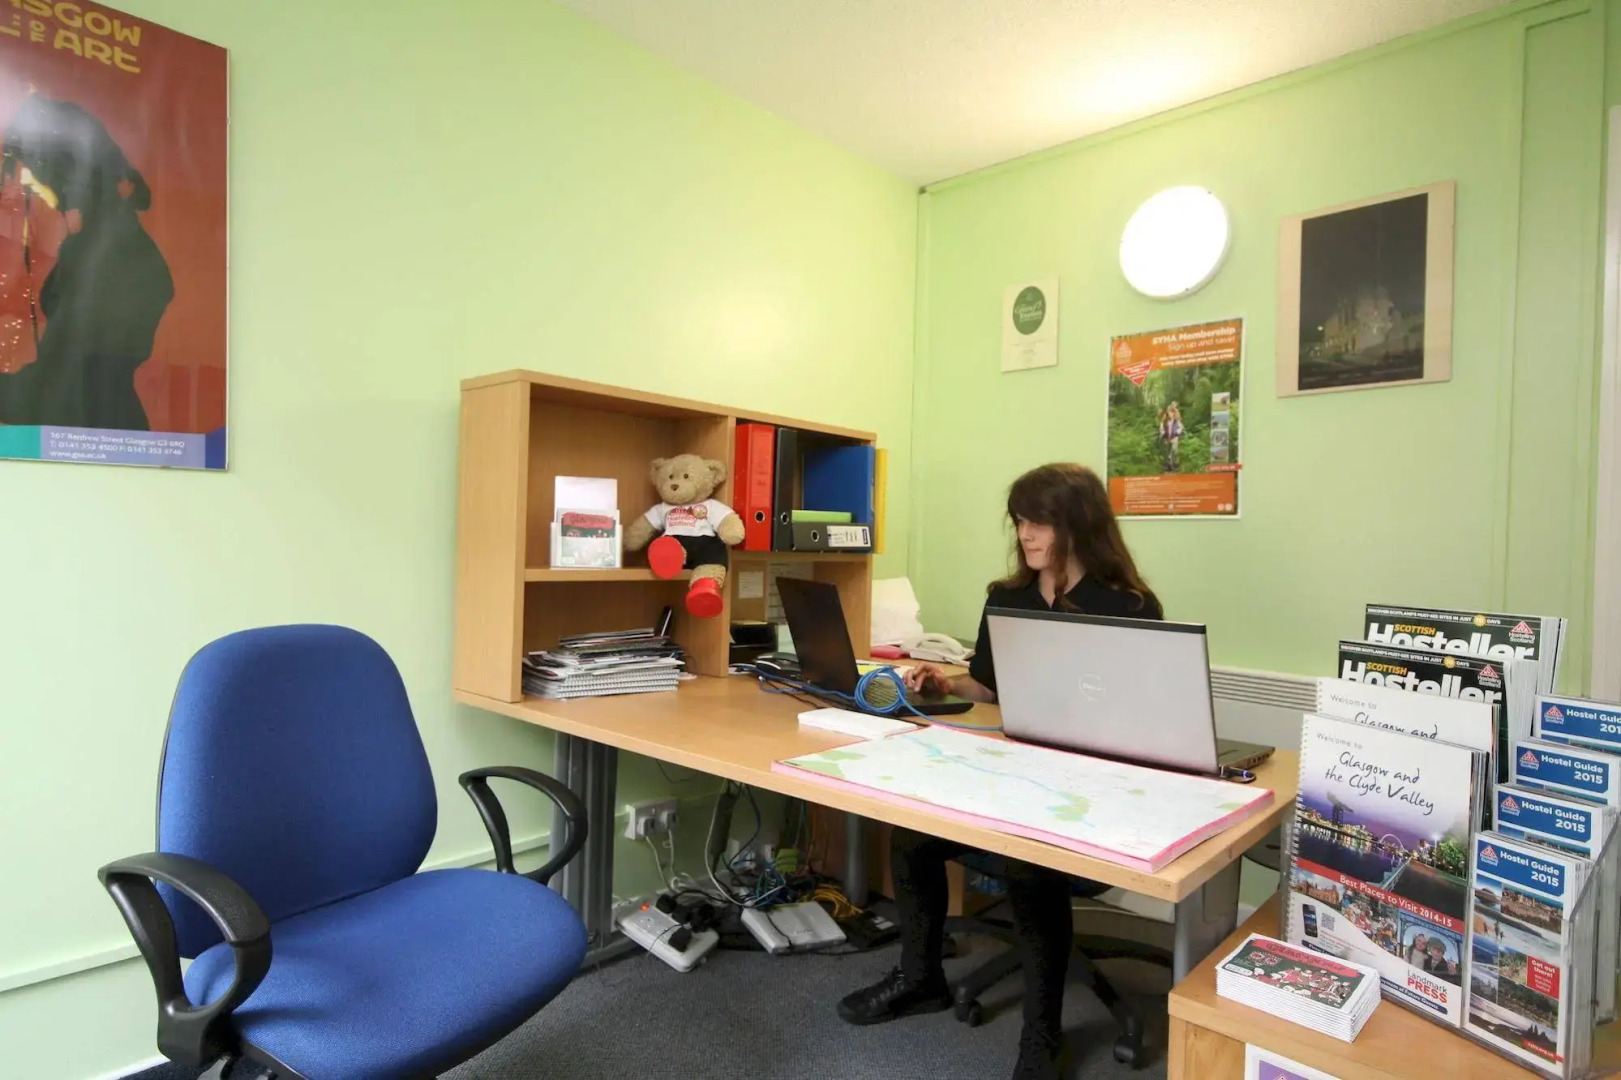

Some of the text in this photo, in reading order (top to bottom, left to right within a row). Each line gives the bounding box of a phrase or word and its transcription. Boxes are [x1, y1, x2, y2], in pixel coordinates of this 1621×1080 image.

[1179, 327, 1236, 341] Membership
[1168, 342, 1185, 351] Sign
[1186, 341, 1197, 349] up
[1198, 339, 1213, 347] and
[67, 432, 100, 442] Renfrew
[125, 437, 156, 447] Glasgow
[1394, 623, 1436, 635] SCOTTISH
[1367, 622, 1535, 660] Hosteller
[1367, 661, 1407, 675] SCOTTISH
[1341, 659, 1502, 703] Hosteller
[1330, 694, 1377, 710] Welcome to
[1566, 708, 1597, 720] Hostel
[1411, 724, 1438, 739] and
[1317, 732, 1363, 750] Welcome to
[1339, 751, 1420, 784] Glasgow and
[1541, 754, 1604, 774] Hostel Guide
[1574, 771, 1603, 785] 2015
[1325, 765, 1434, 816] the Clyde Valley
[1521, 800, 1586, 822] Hostel Guide
[1555, 818, 1586, 833] 2015
[1500, 851, 1560, 876] Hostel Guide
[1530, 871, 1559, 887] 2015
[1340, 874, 1452, 928] Best Places to Visit 2014-15
[1544, 965, 1555, 973] out
[1407, 969, 1448, 994] Landmark
[1407, 977, 1448, 1003] PRESS
